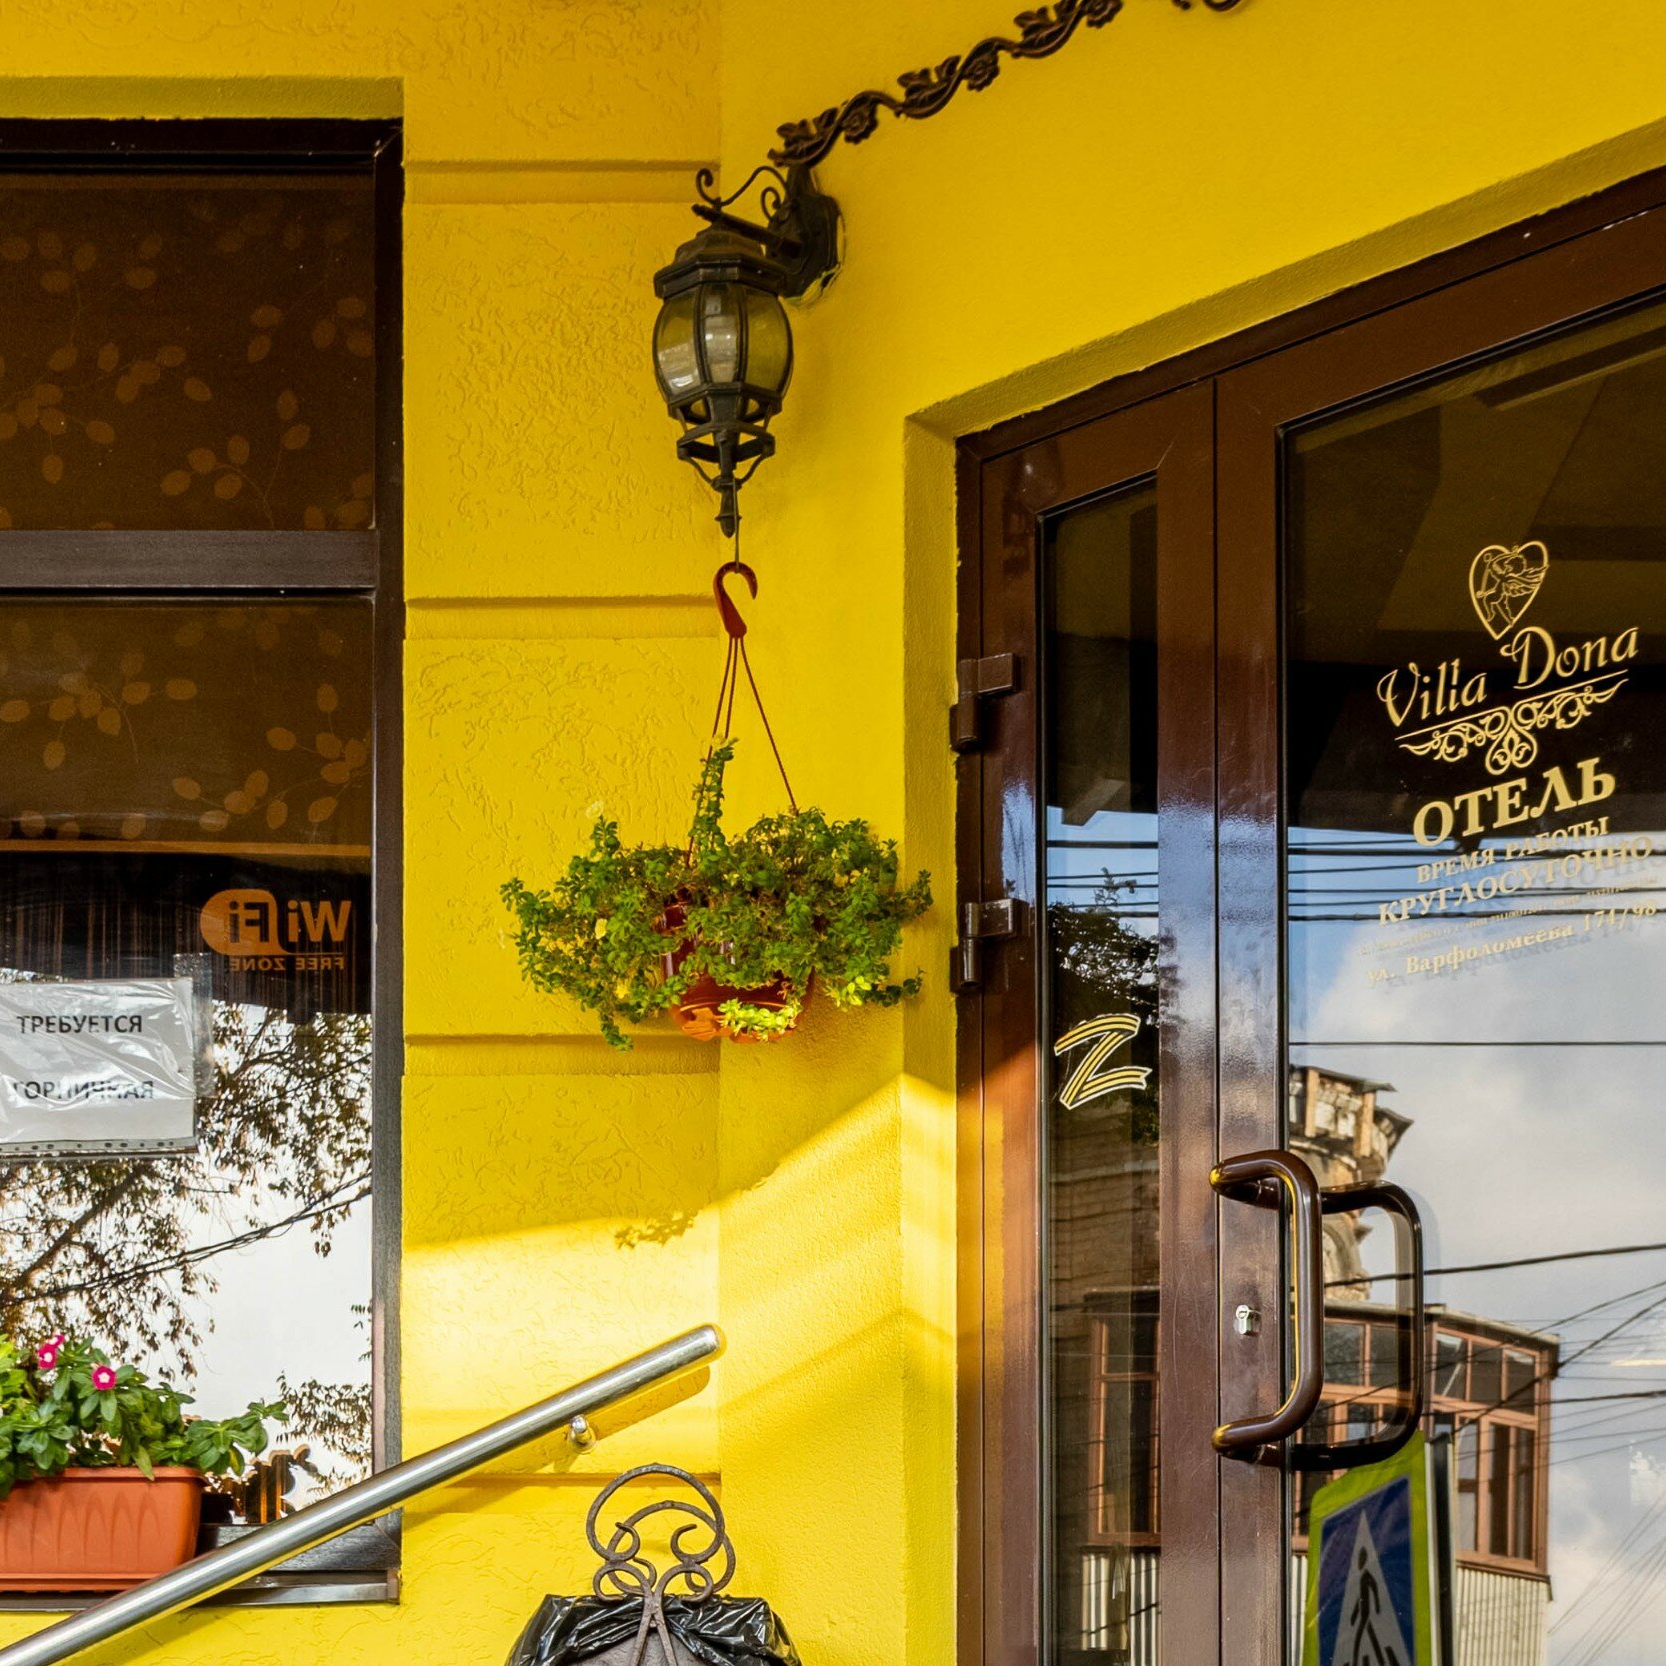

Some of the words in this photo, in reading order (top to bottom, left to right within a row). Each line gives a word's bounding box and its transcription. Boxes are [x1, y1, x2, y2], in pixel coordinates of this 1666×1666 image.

[1377, 658, 1487, 727] Villa
[1500, 627, 1639, 690] Dona
[1412, 757, 1616, 847] ОТЕЛЬ
[1379, 836, 1653, 926] КРУГЛОСУТОЧНО
[1416, 848, 1496, 885] ВРЕМЯ
[1505, 816, 1609, 861] РАБОТЫ
[17, 1014, 142, 1033] ТРЕБУЕТСЯ
[1053, 1012, 1153, 1111] Z
